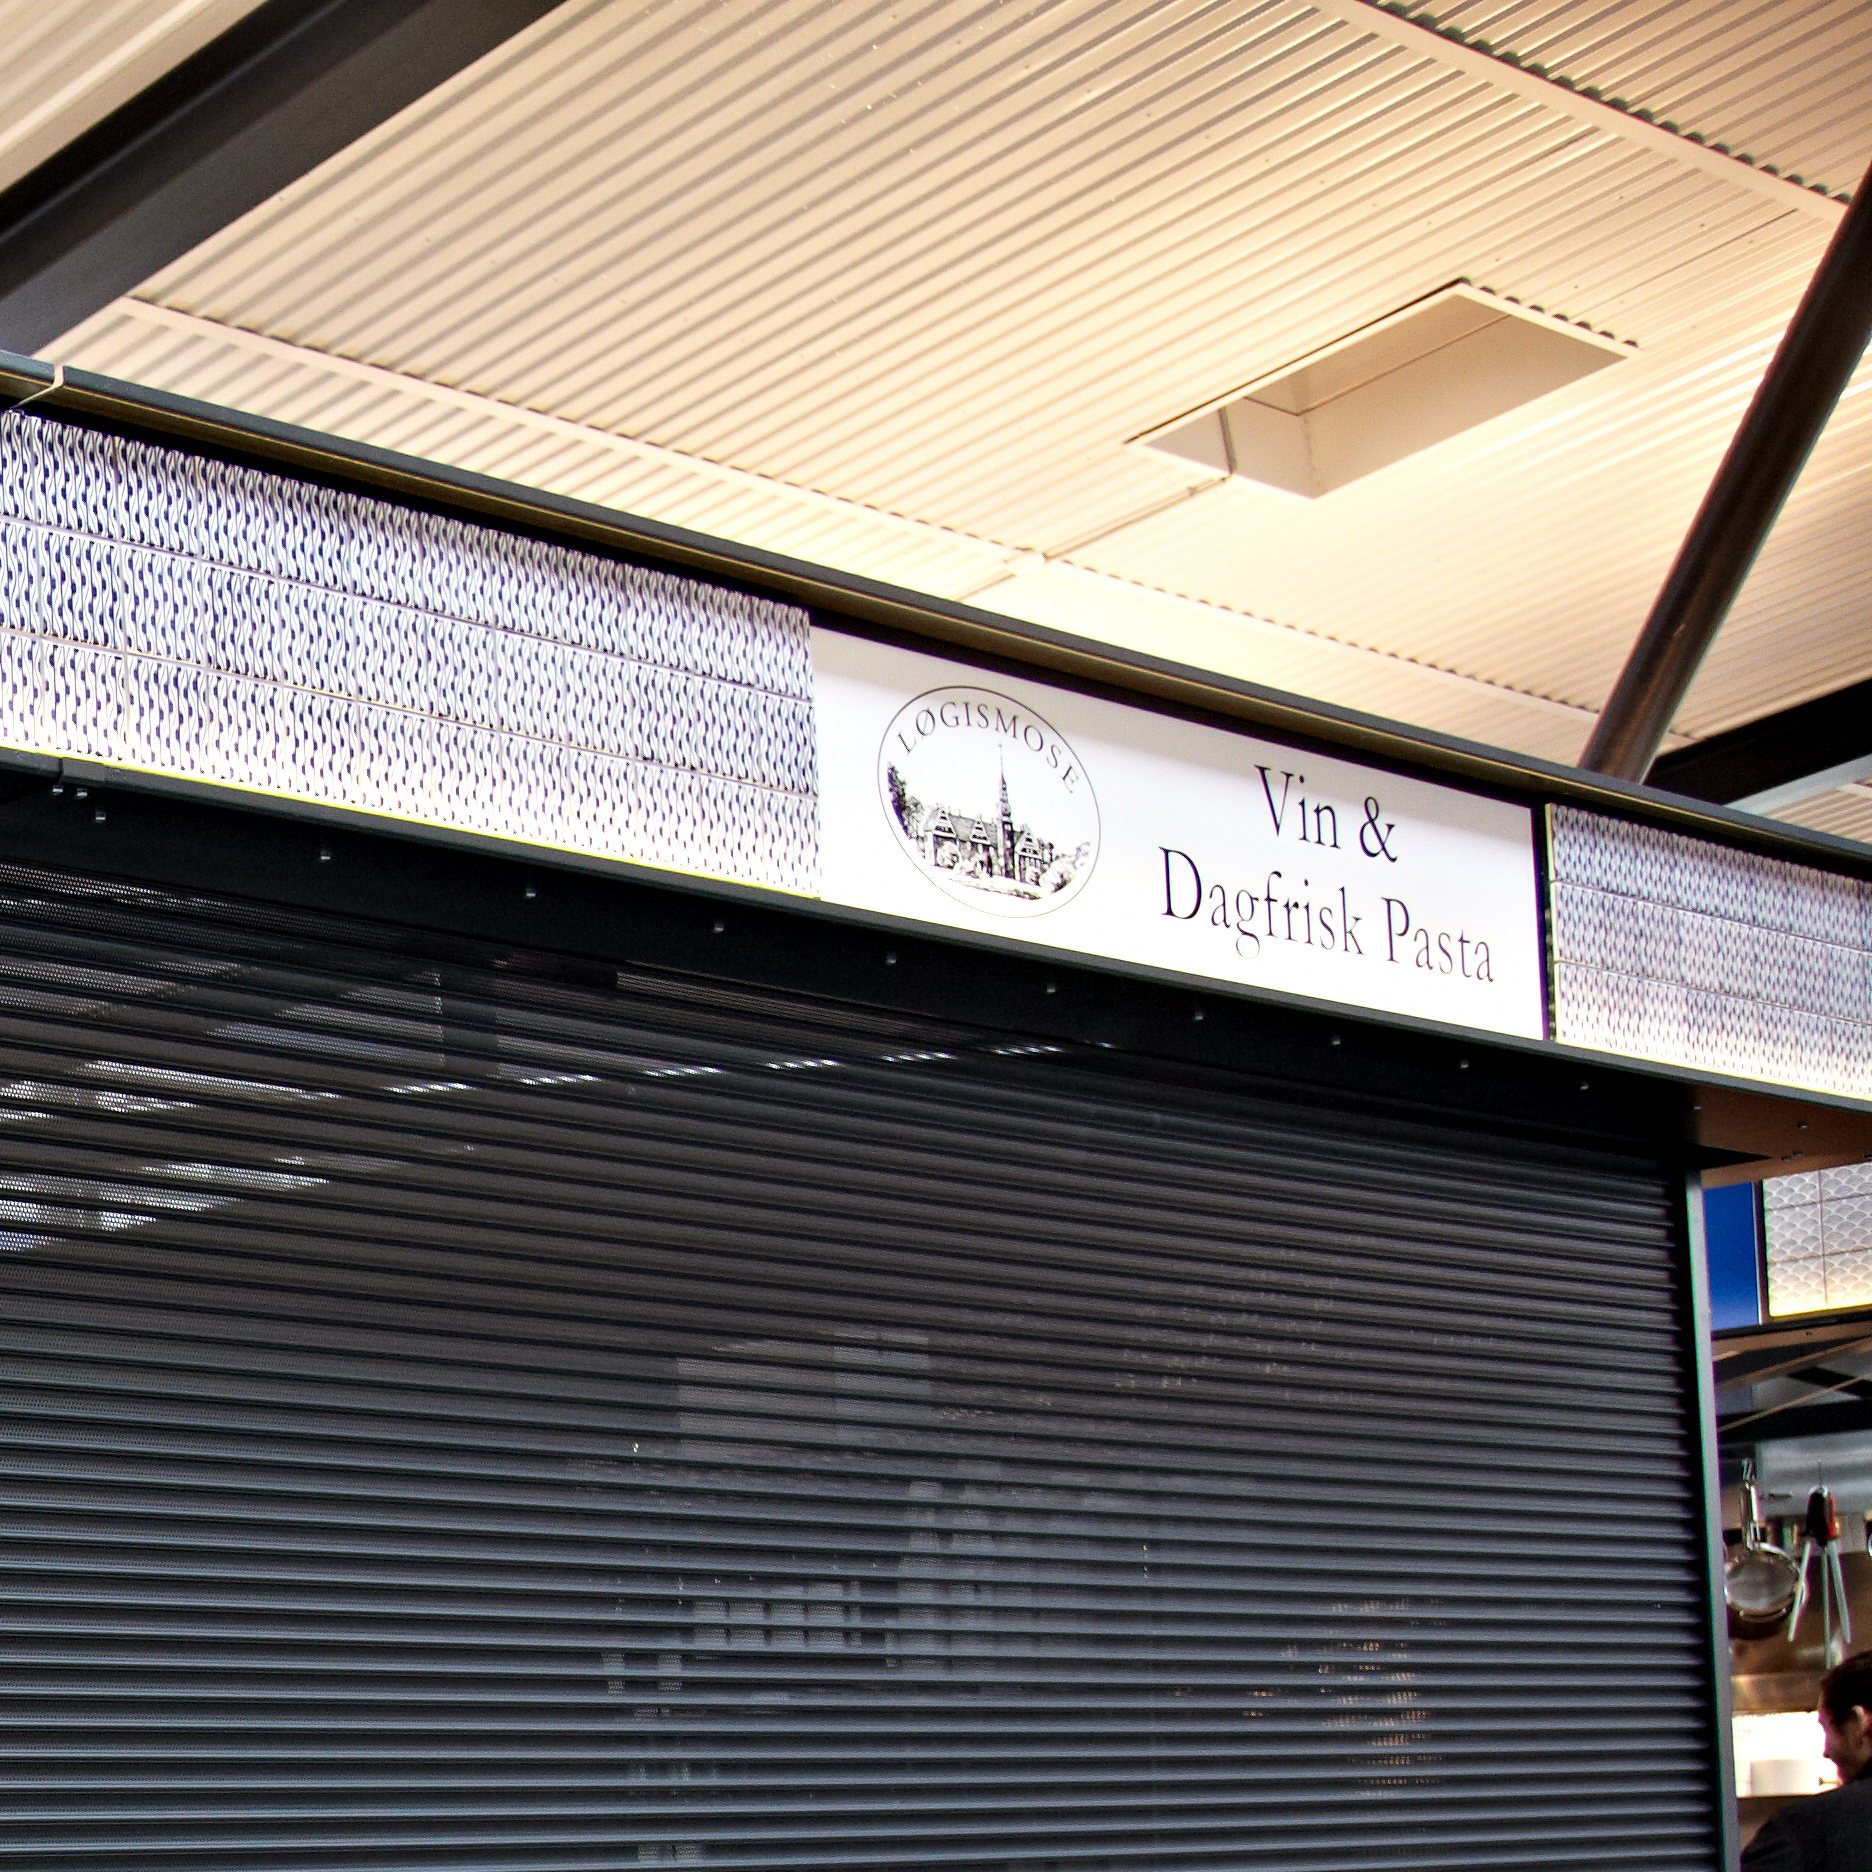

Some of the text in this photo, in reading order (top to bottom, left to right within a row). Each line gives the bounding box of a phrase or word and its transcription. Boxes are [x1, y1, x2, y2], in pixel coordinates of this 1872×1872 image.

[897, 700, 1081, 795] LØGISMOSE
[1254, 764, 1399, 863] Vin &
[1158, 846, 1495, 983] Dagfrisk Pasta
